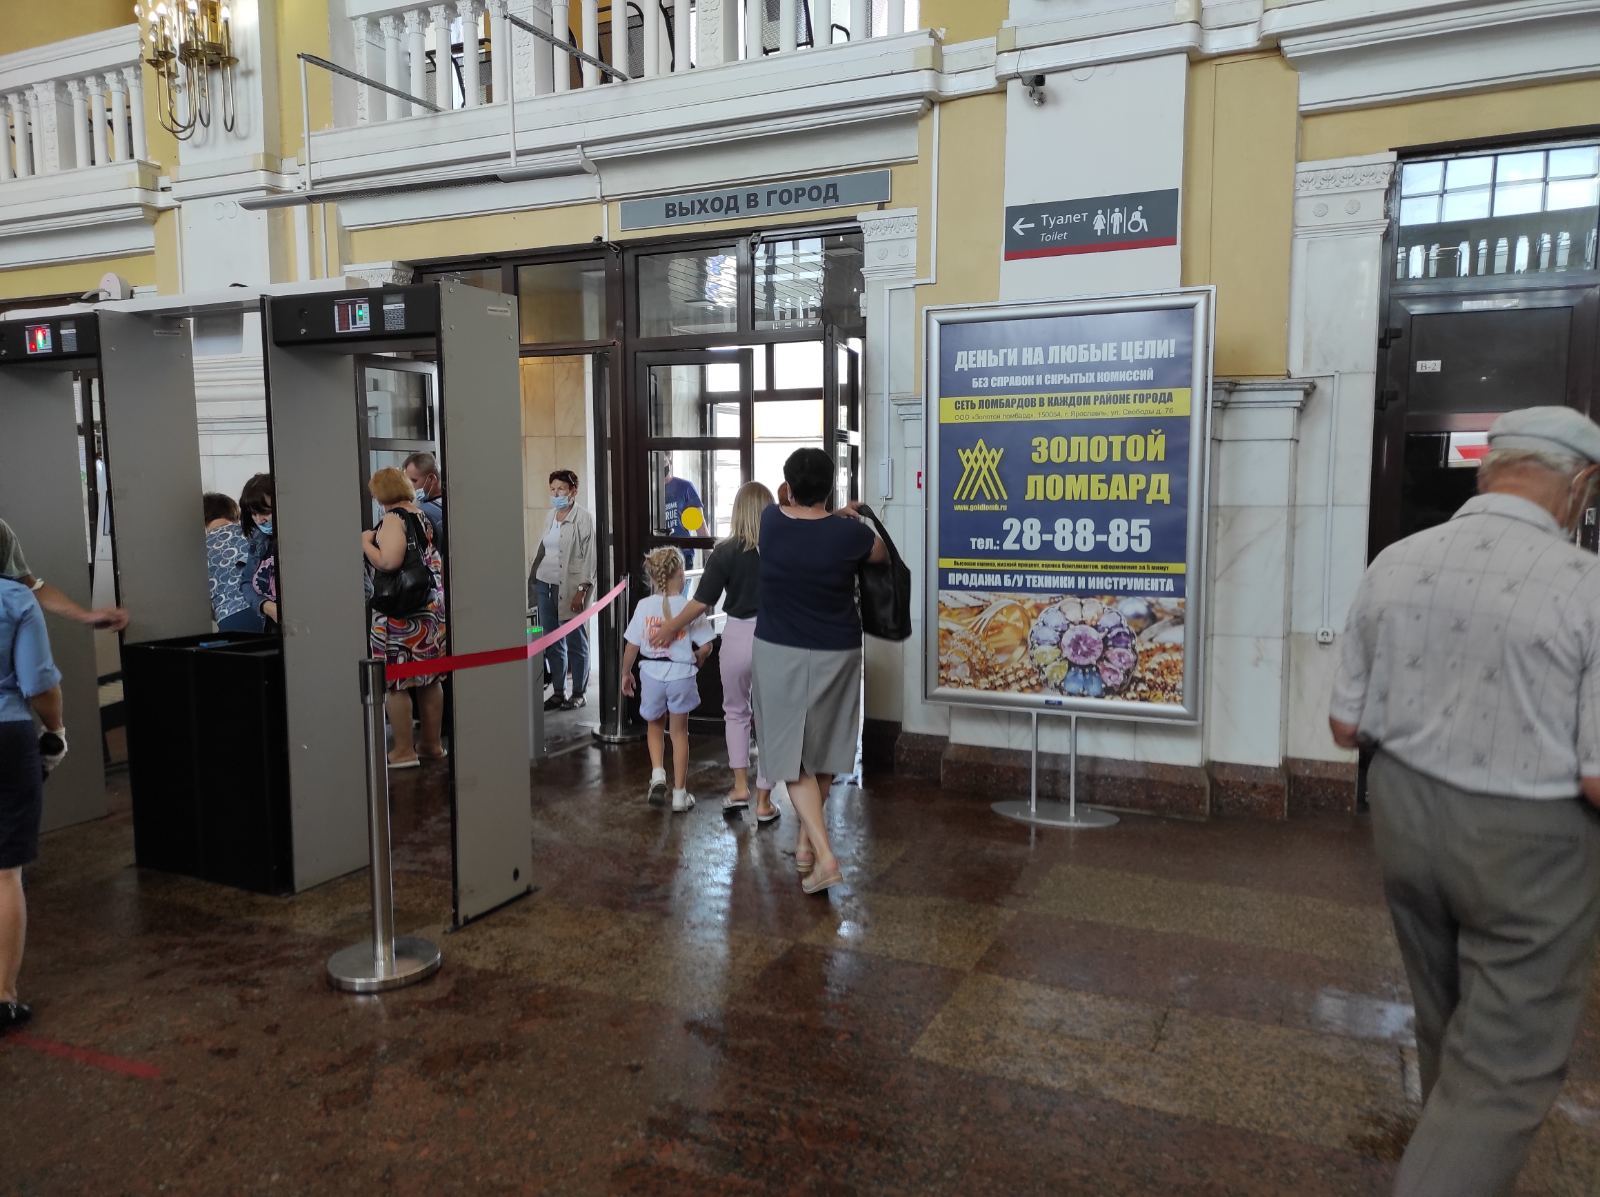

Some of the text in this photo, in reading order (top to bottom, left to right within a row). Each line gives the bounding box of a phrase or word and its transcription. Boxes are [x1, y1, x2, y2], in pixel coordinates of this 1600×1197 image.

[664, 183, 840, 219] ВЫХОД В ГОРОД
[1040, 212, 1089, 229] Туалет
[1039, 231, 1069, 243] Toilet
[954, 338, 1176, 372] ДЕНЬГИ НА ЛЮБЫЕ ЦЕЛИ!
[971, 368, 1154, 389] БЕЗ СПРАВОК И СКРЫТЫХ КОМИССИЙ
[954, 391, 1174, 411] СЕТЬ ЛОМБАРДОВ В КАЖДОМ РАЙОНЕ ГОРОДА
[1122, 407, 1155, 416] Свободы
[1030, 428, 1166, 464] ЗОЛОТОЙ
[1024, 473, 1171, 504] ЛОМБАРД
[970, 517, 1152, 553] тел.: 28-88-85
[948, 572, 1175, 592] ПРОДАЖА Б/У ТЕХНИКИ И ИНСТРУМЕНТА
